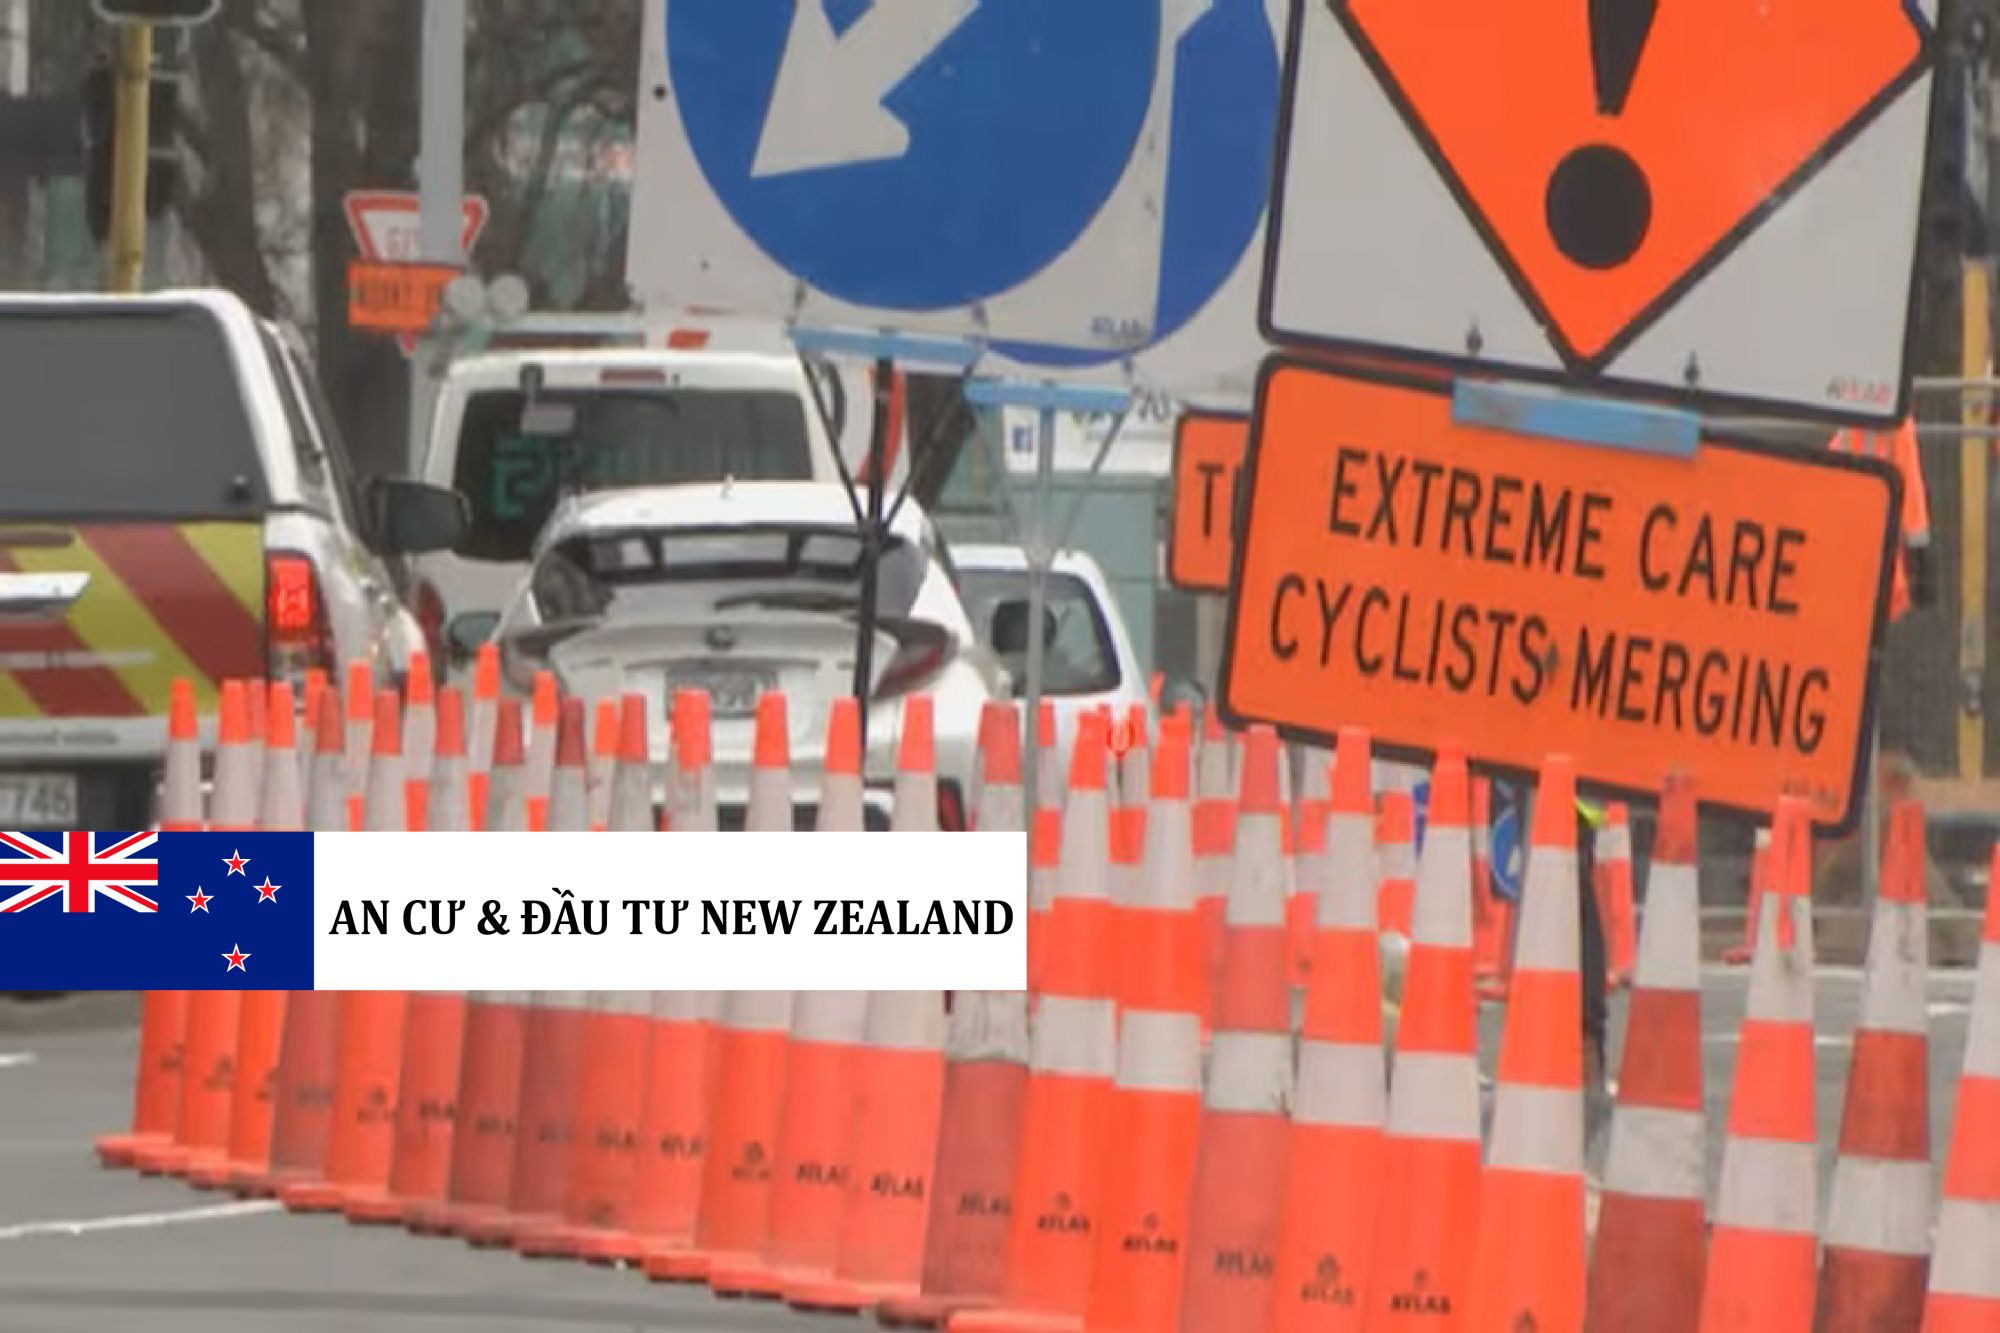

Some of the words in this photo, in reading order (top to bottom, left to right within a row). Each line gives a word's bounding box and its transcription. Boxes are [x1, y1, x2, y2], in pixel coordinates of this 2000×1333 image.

[1329, 448, 1613, 580] EXTREME
[1640, 504, 1806, 614] CARE
[1270, 574, 1547, 706] CYCLISTS
[1571, 626, 1830, 754] MERGING
